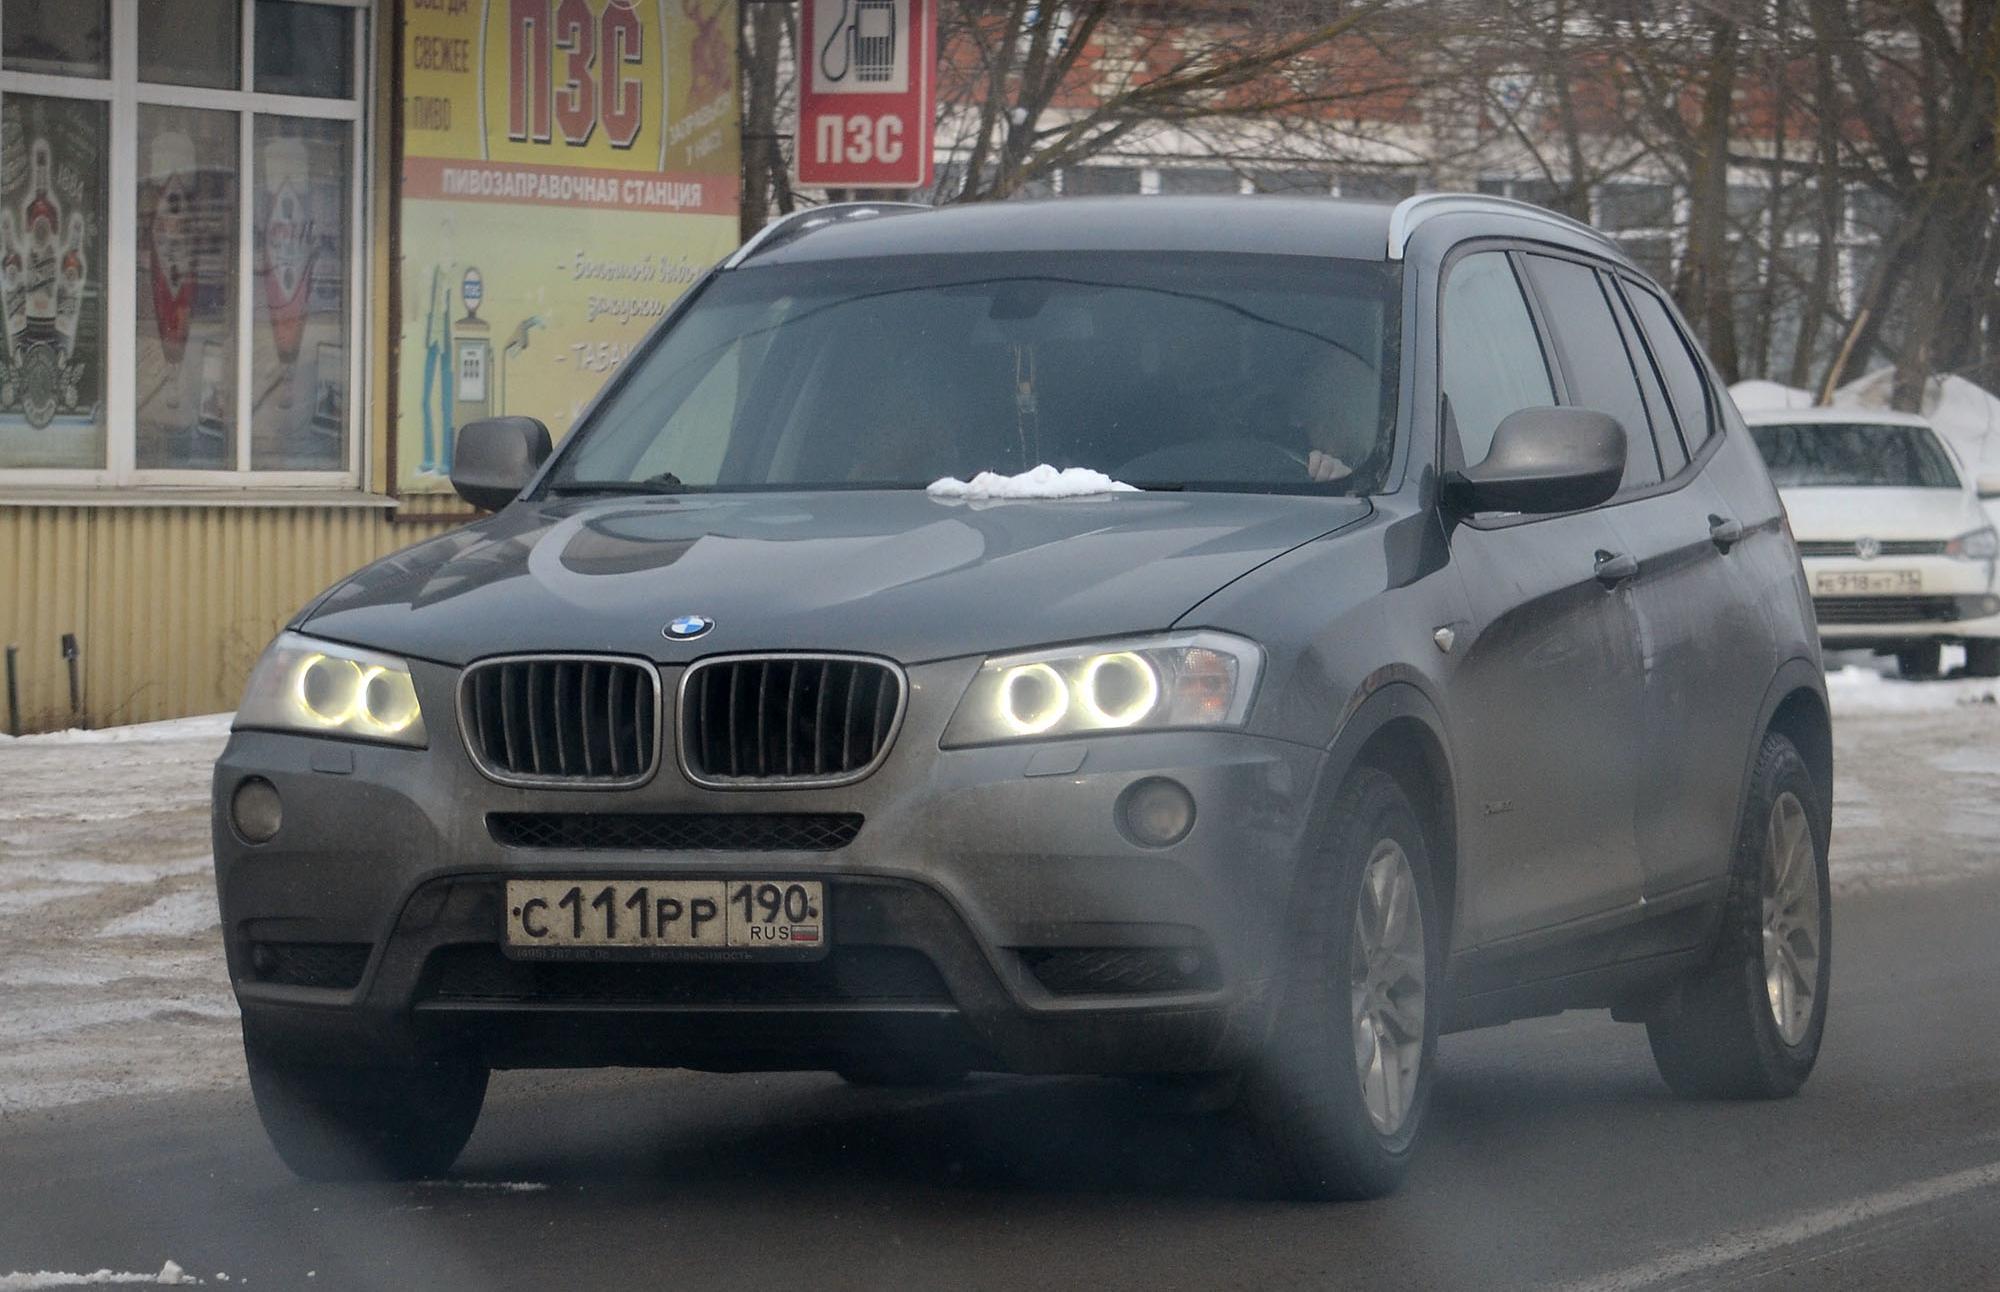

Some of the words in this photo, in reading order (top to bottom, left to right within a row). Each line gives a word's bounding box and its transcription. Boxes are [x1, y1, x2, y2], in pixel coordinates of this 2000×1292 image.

[414, 35, 469, 74] СВЕЖЕЕ
[508, 0, 643, 149] ПЗС
[816, 114, 904, 164] ПЗС
[442, 167, 619, 202] ПИВОЗАПРАВОЧНАЯ
[622, 179, 703, 211] СТАНЦИЯ
[731, 883, 809, 924] 190
[751, 925, 790, 941] RUS
